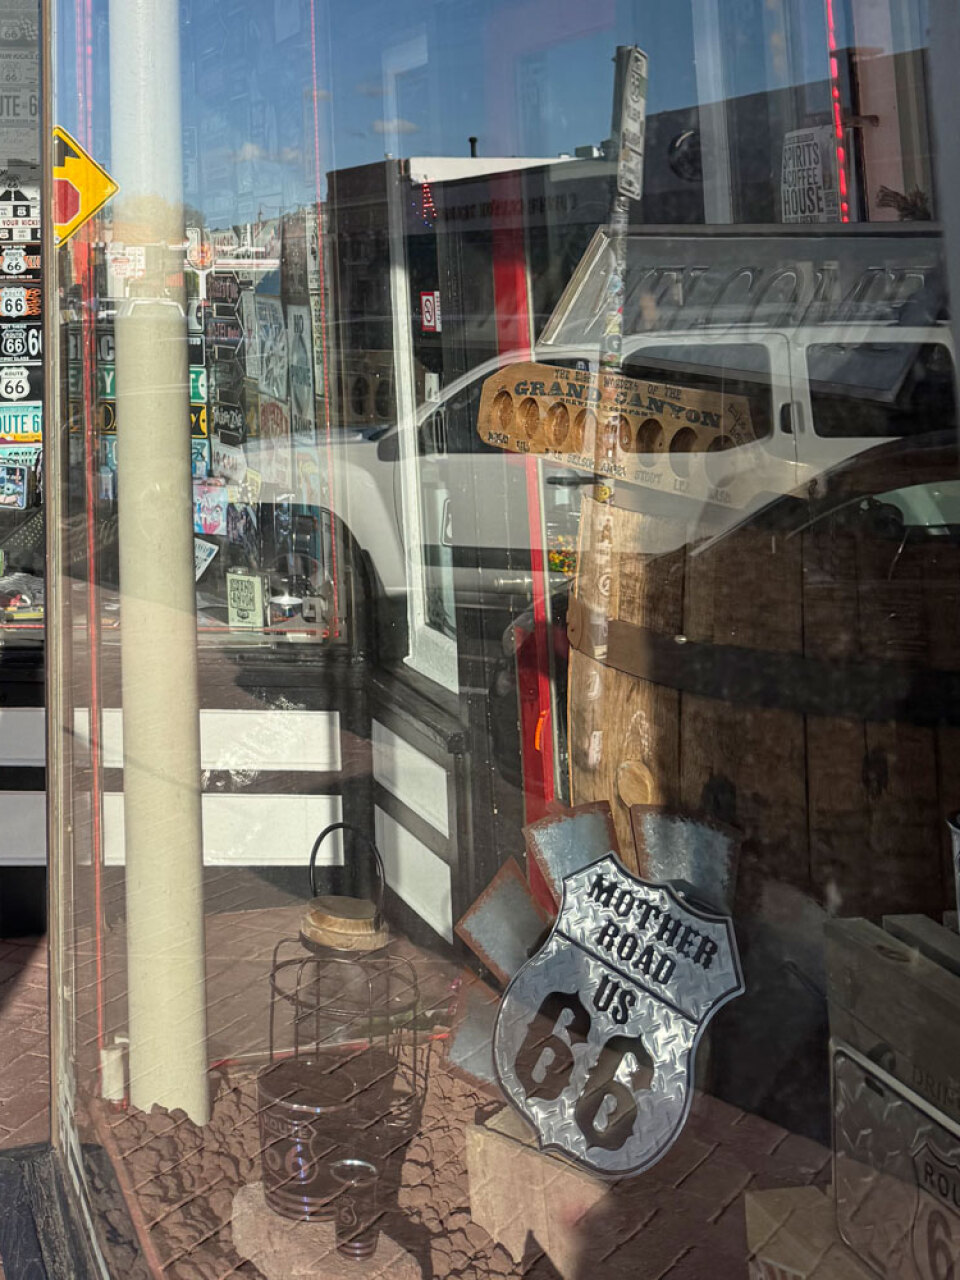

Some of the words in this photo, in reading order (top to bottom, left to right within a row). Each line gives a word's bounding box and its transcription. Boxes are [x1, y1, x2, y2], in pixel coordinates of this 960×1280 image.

[784, 186, 824, 216] HOUSE
[7, 261, 22, 271] 66
[4, 297, 24, 313] 66
[6, 338, 24, 353] 66
[27, 328, 42, 357] 6
[4, 379, 25, 395] 66
[514, 379, 602, 402] GRAND
[647, 384, 659, 395] OF
[587, 873, 718, 970] MOTHER
[595, 919, 677, 986] ROAD
[592, 976, 637, 1025] US
[515, 991, 655, 1150] 66
